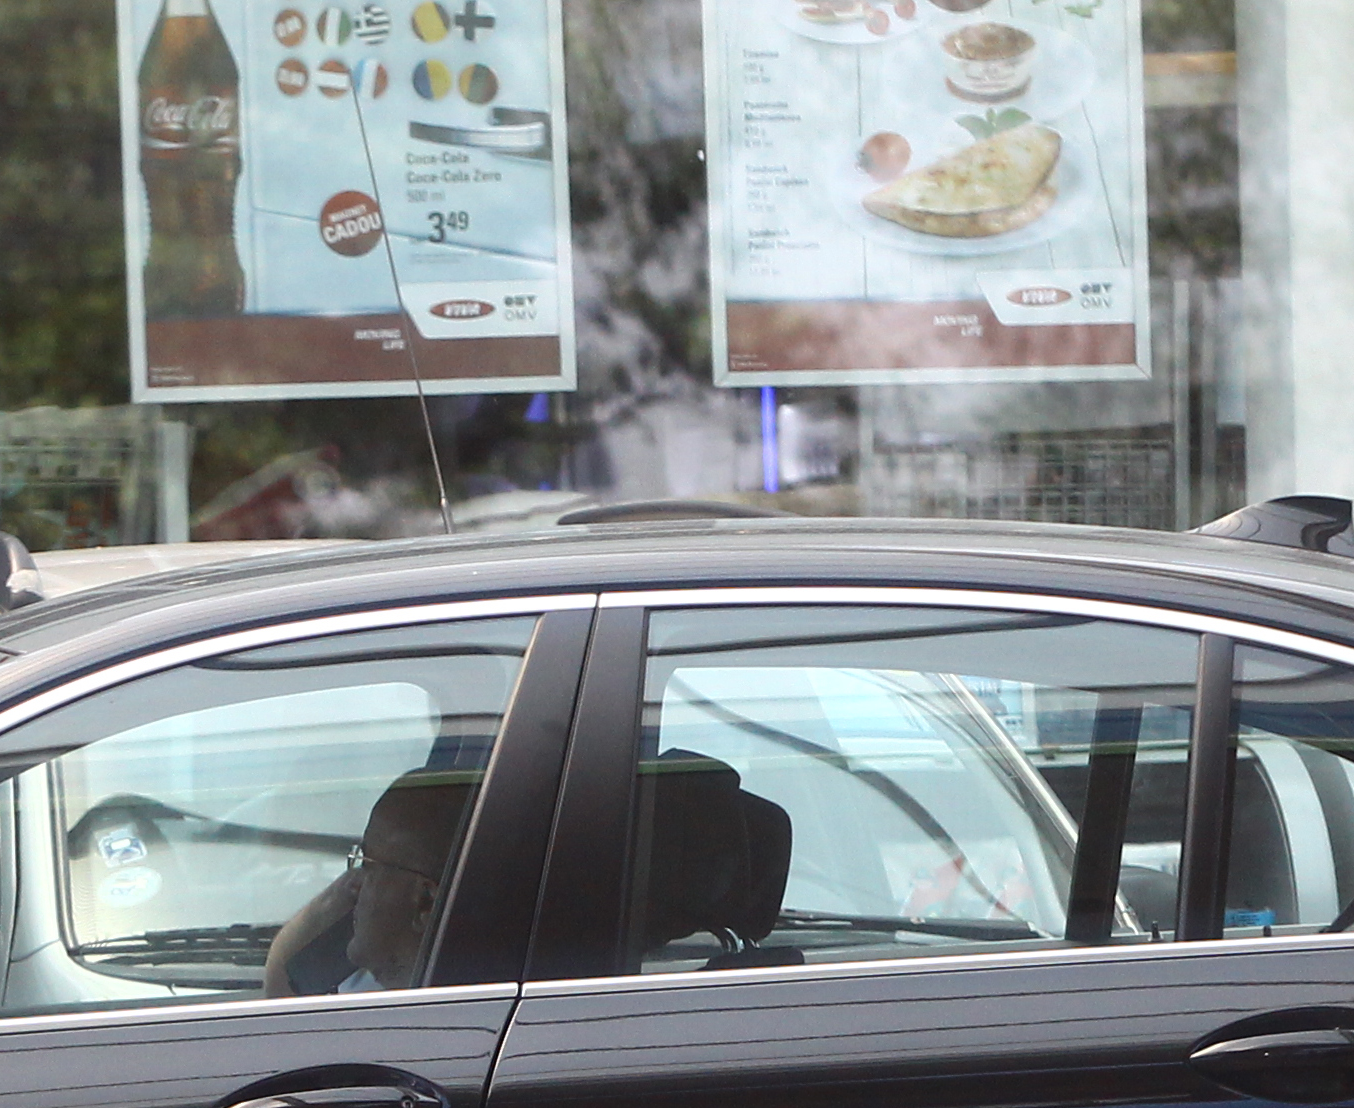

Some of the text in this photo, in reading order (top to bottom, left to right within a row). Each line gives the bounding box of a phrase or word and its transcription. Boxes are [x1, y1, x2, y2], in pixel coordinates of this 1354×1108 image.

[406, 153, 470, 165] Coca-Cola
[406, 170, 502, 184] Coca-Cola Zero
[322, 212, 383, 245] CADOU
[505, 310, 538, 321] OMV
